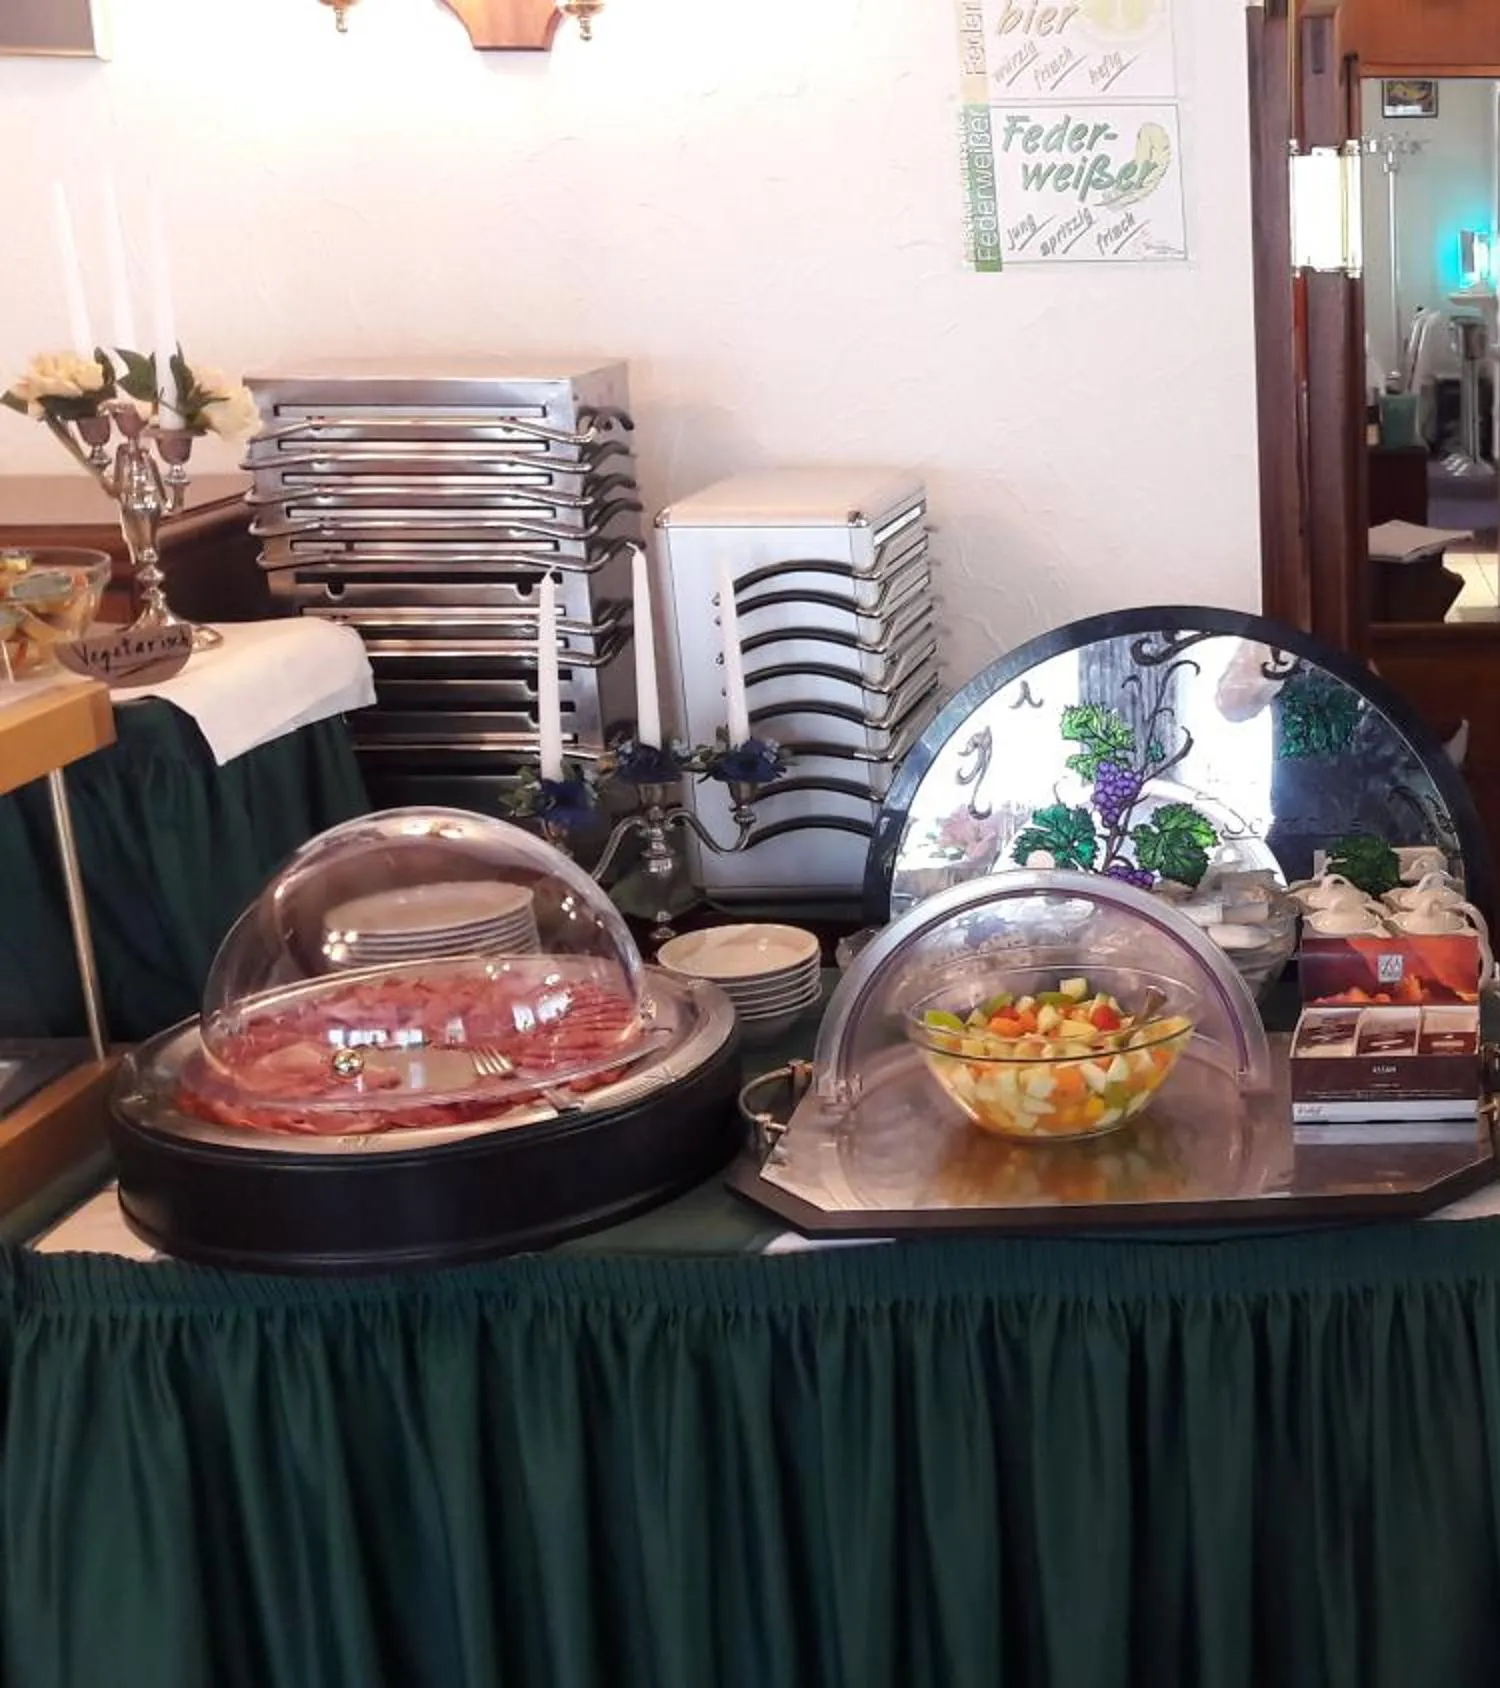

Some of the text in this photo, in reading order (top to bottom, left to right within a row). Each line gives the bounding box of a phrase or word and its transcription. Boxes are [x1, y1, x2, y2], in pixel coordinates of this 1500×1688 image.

[1002, 113, 1119, 153] Feder-
[1021, 154, 1159, 202] weißer
[1006, 208, 1137, 256] jung spritzig frisch
